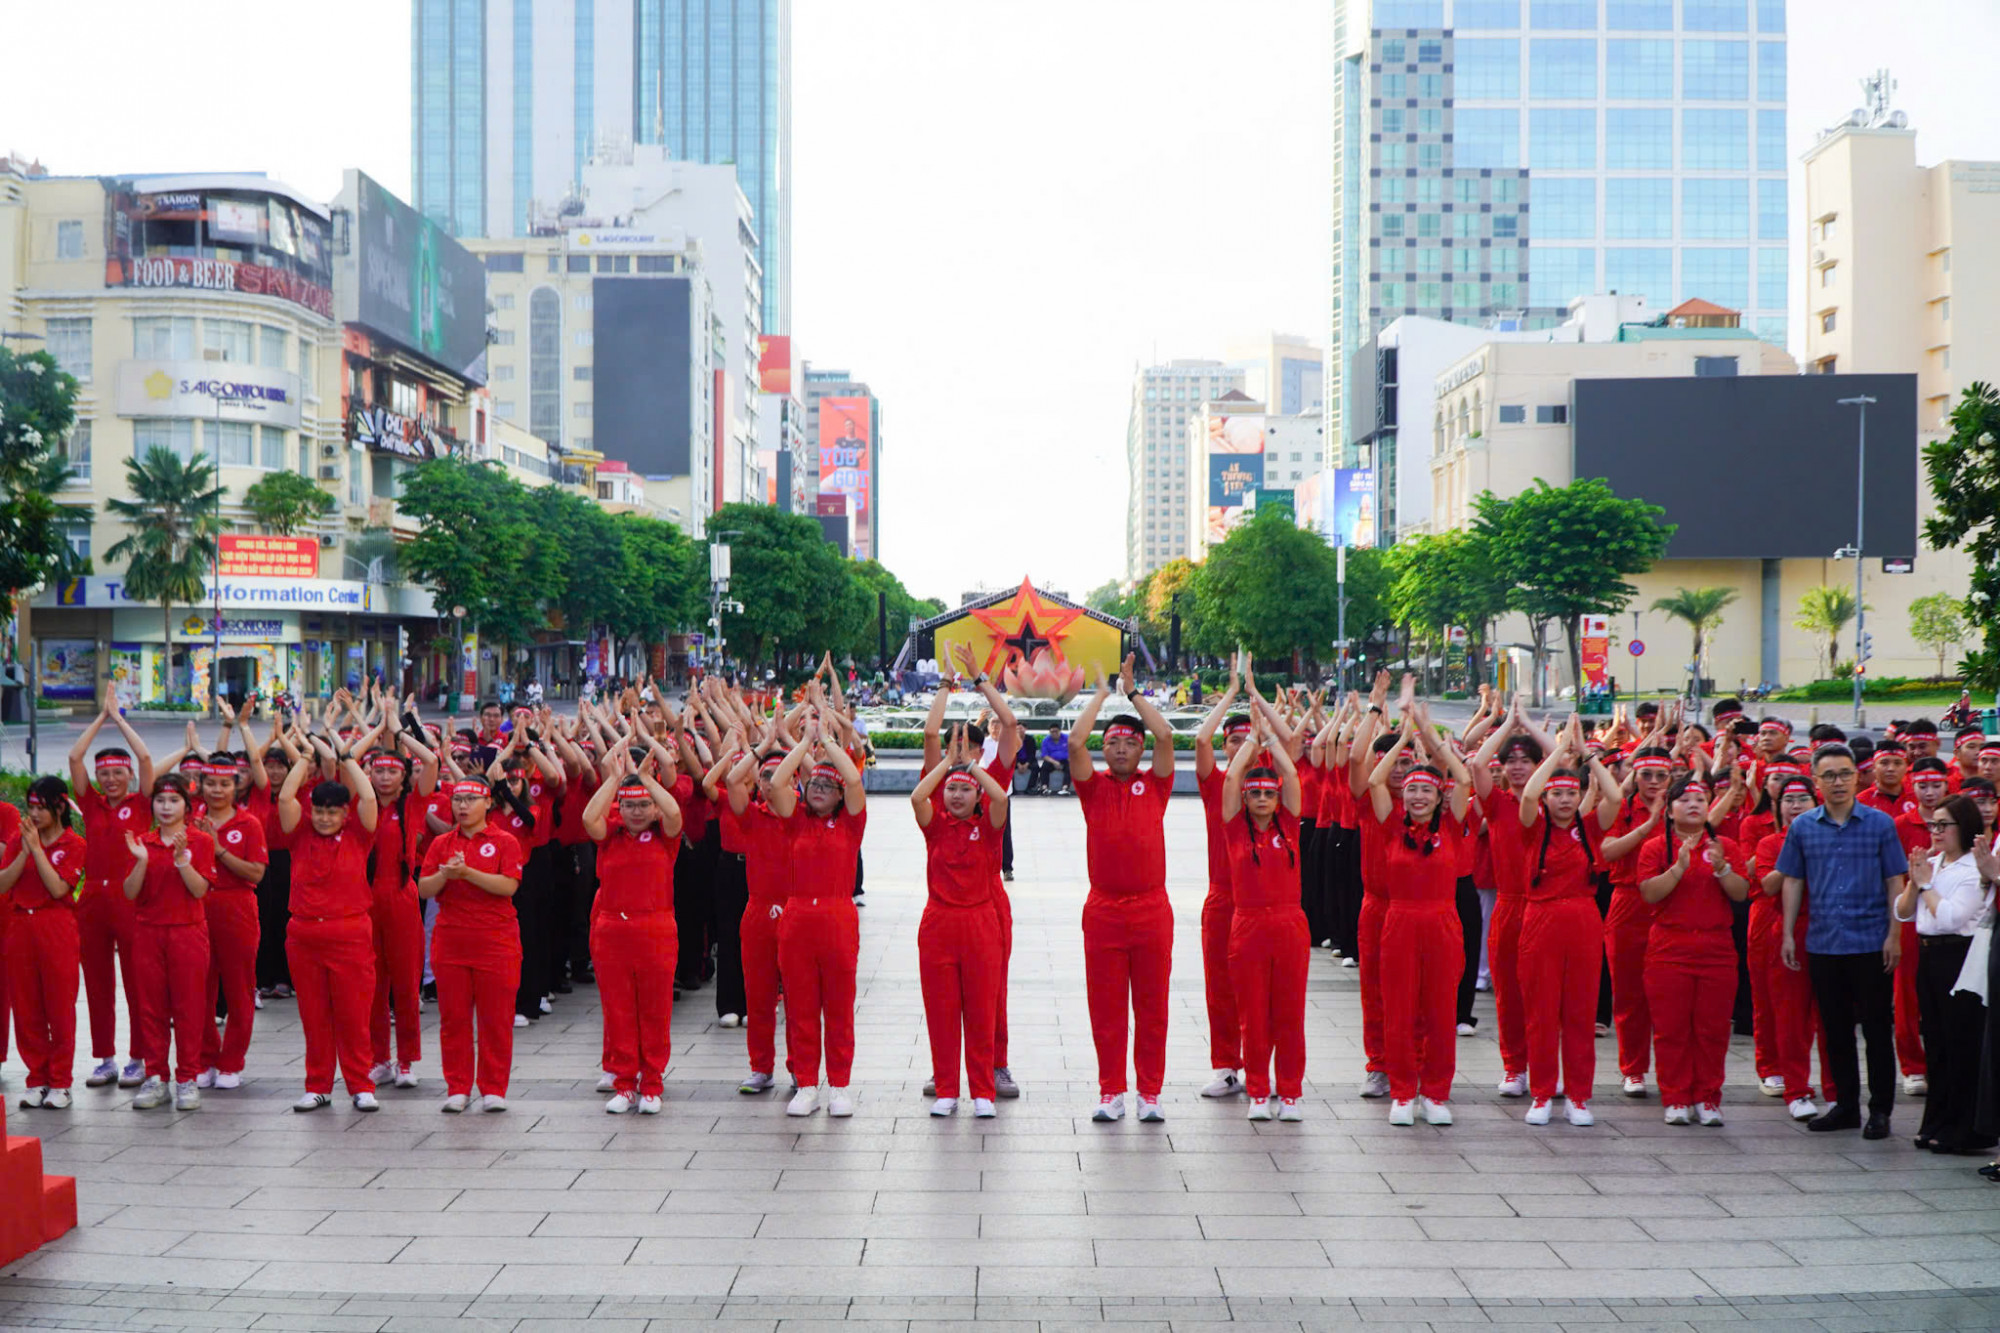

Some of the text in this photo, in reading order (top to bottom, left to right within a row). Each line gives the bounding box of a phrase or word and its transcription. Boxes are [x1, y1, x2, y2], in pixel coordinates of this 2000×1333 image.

[133, 259, 235, 291] FOOD & BEER
[820, 447, 858, 466] YOU
[833, 469, 869, 489] GOT
[328, 586, 360, 604] Center
